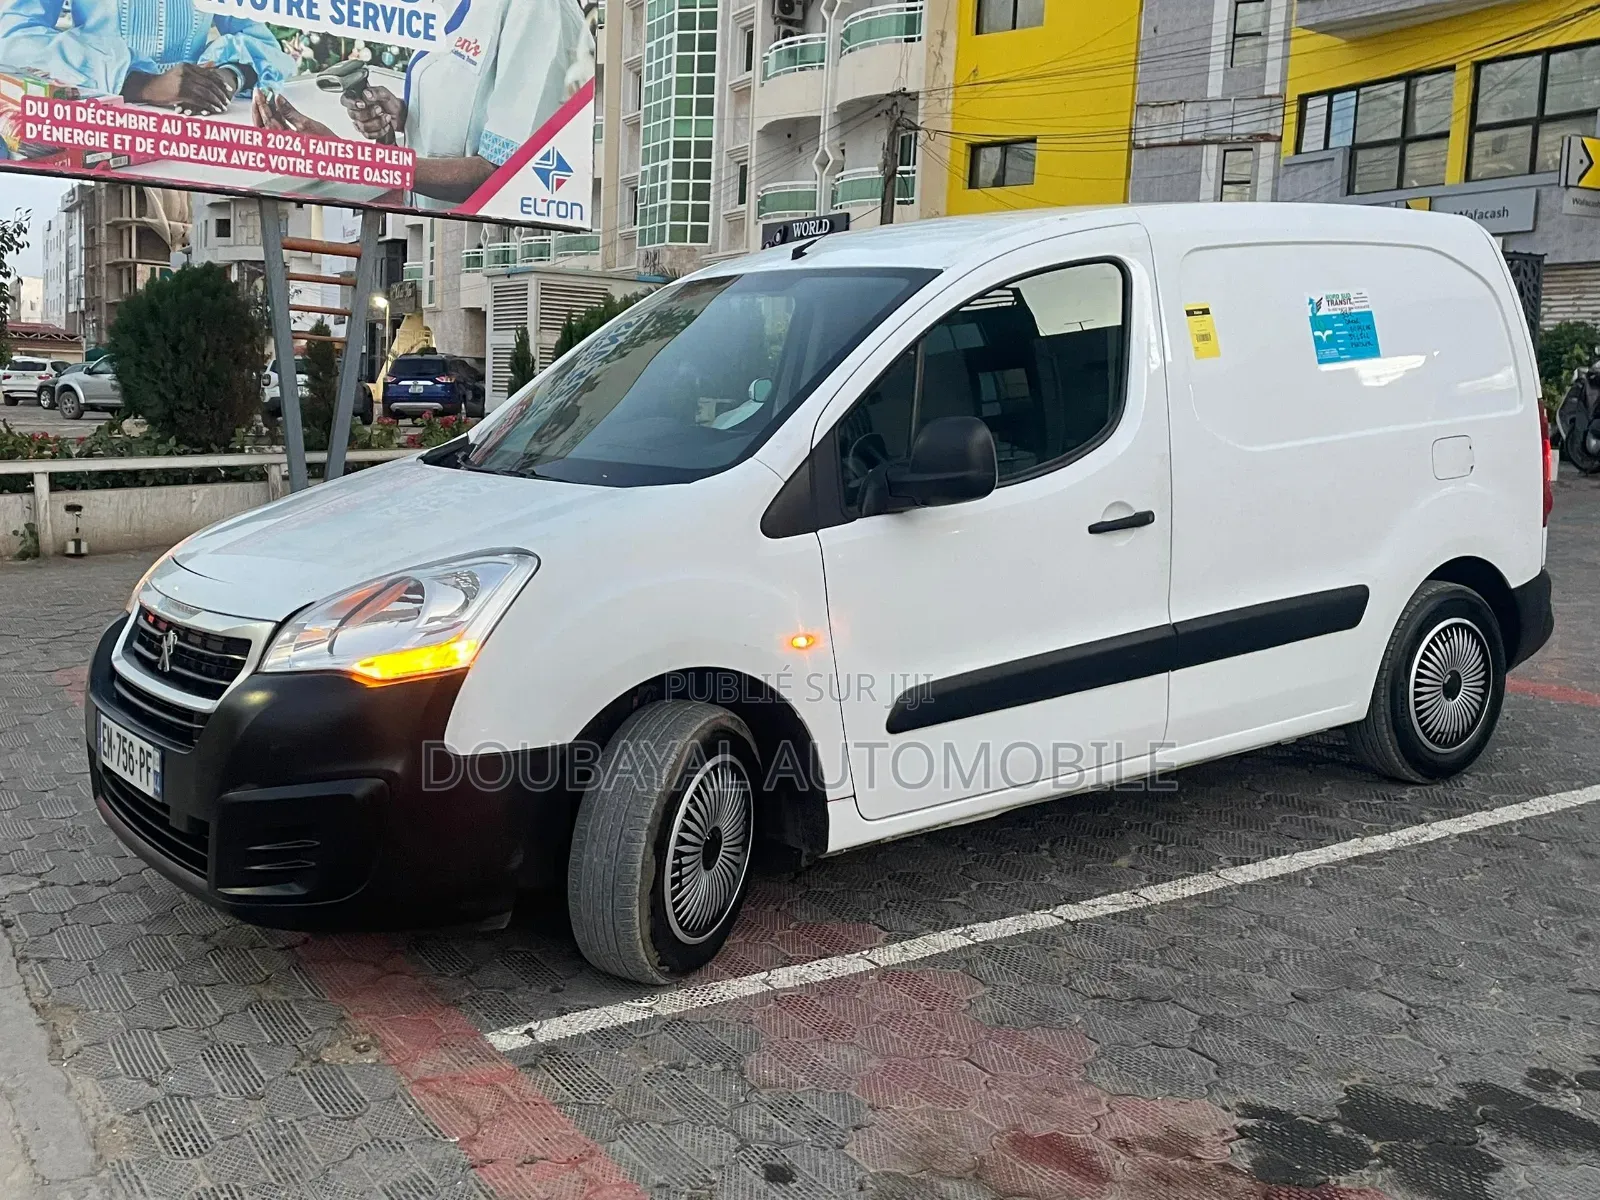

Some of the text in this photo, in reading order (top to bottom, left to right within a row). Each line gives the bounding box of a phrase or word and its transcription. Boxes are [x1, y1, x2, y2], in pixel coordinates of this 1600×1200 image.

[329, 0, 436, 41] SERVICE
[25, 100, 413, 167] DU 01 DÉCEMBRE AU 15 JANVIER 2026, FAITES LE PLEIN
[25, 120, 109, 149] D'ÉNERGIE
[113, 133, 132, 151] ET
[135, 136, 155, 155] DE
[159, 141, 228, 164] CADEAUX
[230, 149, 266, 168] AVEC
[268, 154, 314, 174] VOTRE
[317, 160, 360, 180] CARTE
[363, 166, 402, 185] OASIS
[793, 219, 830, 238] WORLD
